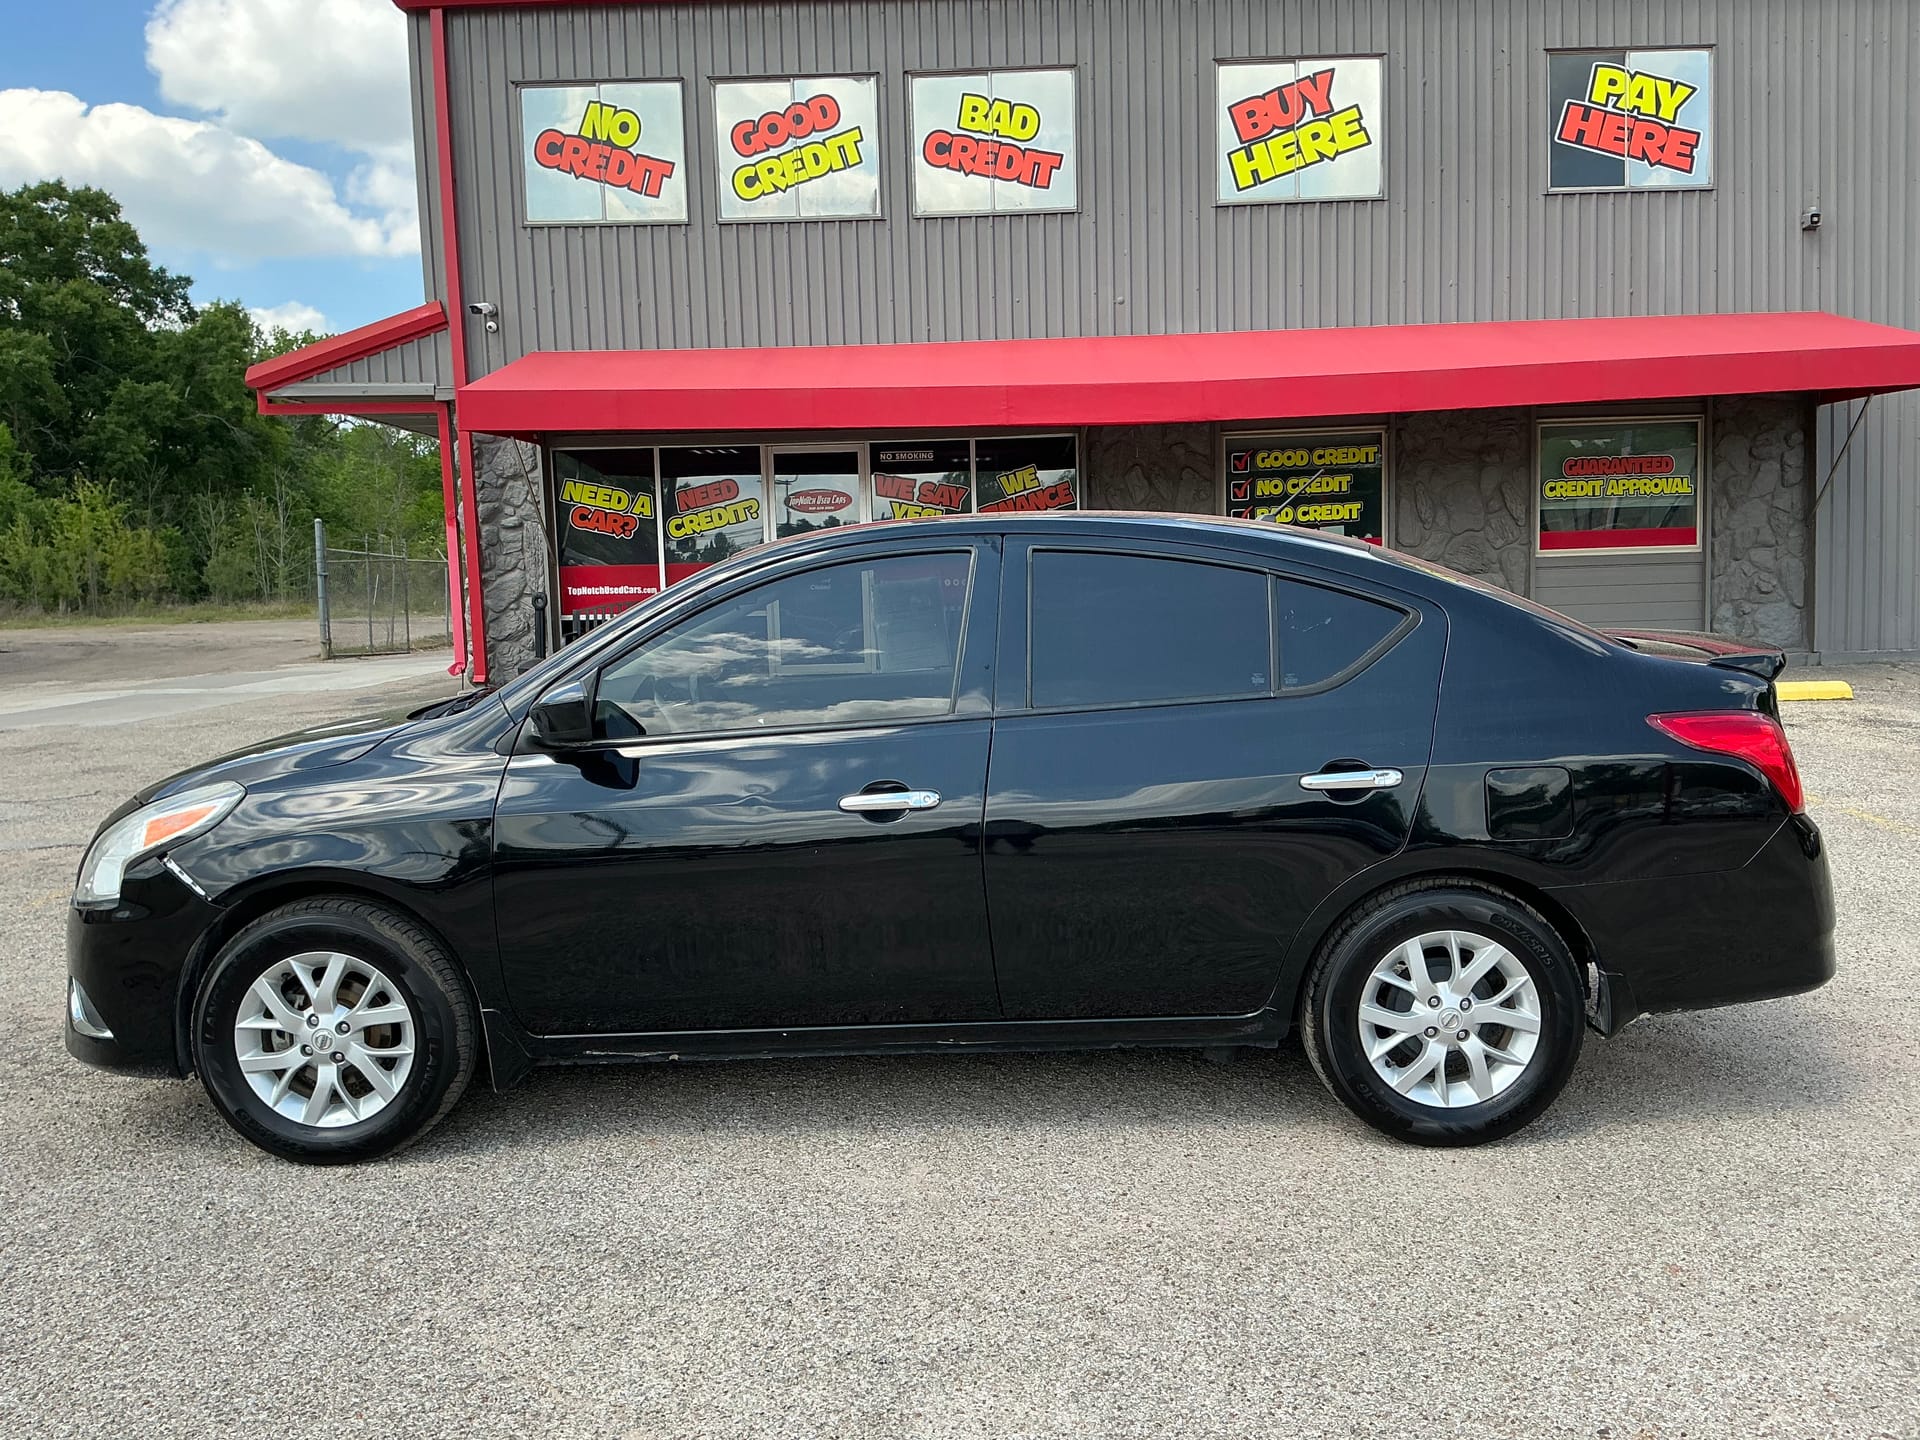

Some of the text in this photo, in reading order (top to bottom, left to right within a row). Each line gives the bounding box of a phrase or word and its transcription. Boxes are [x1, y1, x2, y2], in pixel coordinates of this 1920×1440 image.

[1229, 68, 1334, 143] BUY
[1589, 64, 1697, 124] PAY
[580, 101, 641, 147] NO
[731, 94, 840, 156] GOOD
[957, 93, 1040, 141] BAD
[1228, 104, 1371, 191] HERE
[1557, 100, 1700, 174] HERE
[534, 129, 675, 198] CREDIT
[732, 127, 863, 201] CREDIT
[923, 130, 1062, 189] CREDIT
[896, 452, 934, 460] SMOKING
[1256, 447, 1378, 468] GOOD CREDIT
[1564, 456, 1674, 476] GUARANTEED
[676, 479, 739, 512] NEED
[875, 474, 968, 509] WE SAY
[979, 481, 1074, 512] NANCE
[999, 465, 1040, 495] WE
[1256, 475, 1352, 496] NO CREDIT
[1544, 477, 1692, 499] CREDIT APPROVAL
[562, 480, 653, 517] NEED A
[1297, 503, 1361, 523] CREDIT
[571, 506, 637, 538] CAR?
[667, 498, 759, 538] CREDIT?
[567, 585, 658, 596] TopNotchUsedCars.com
